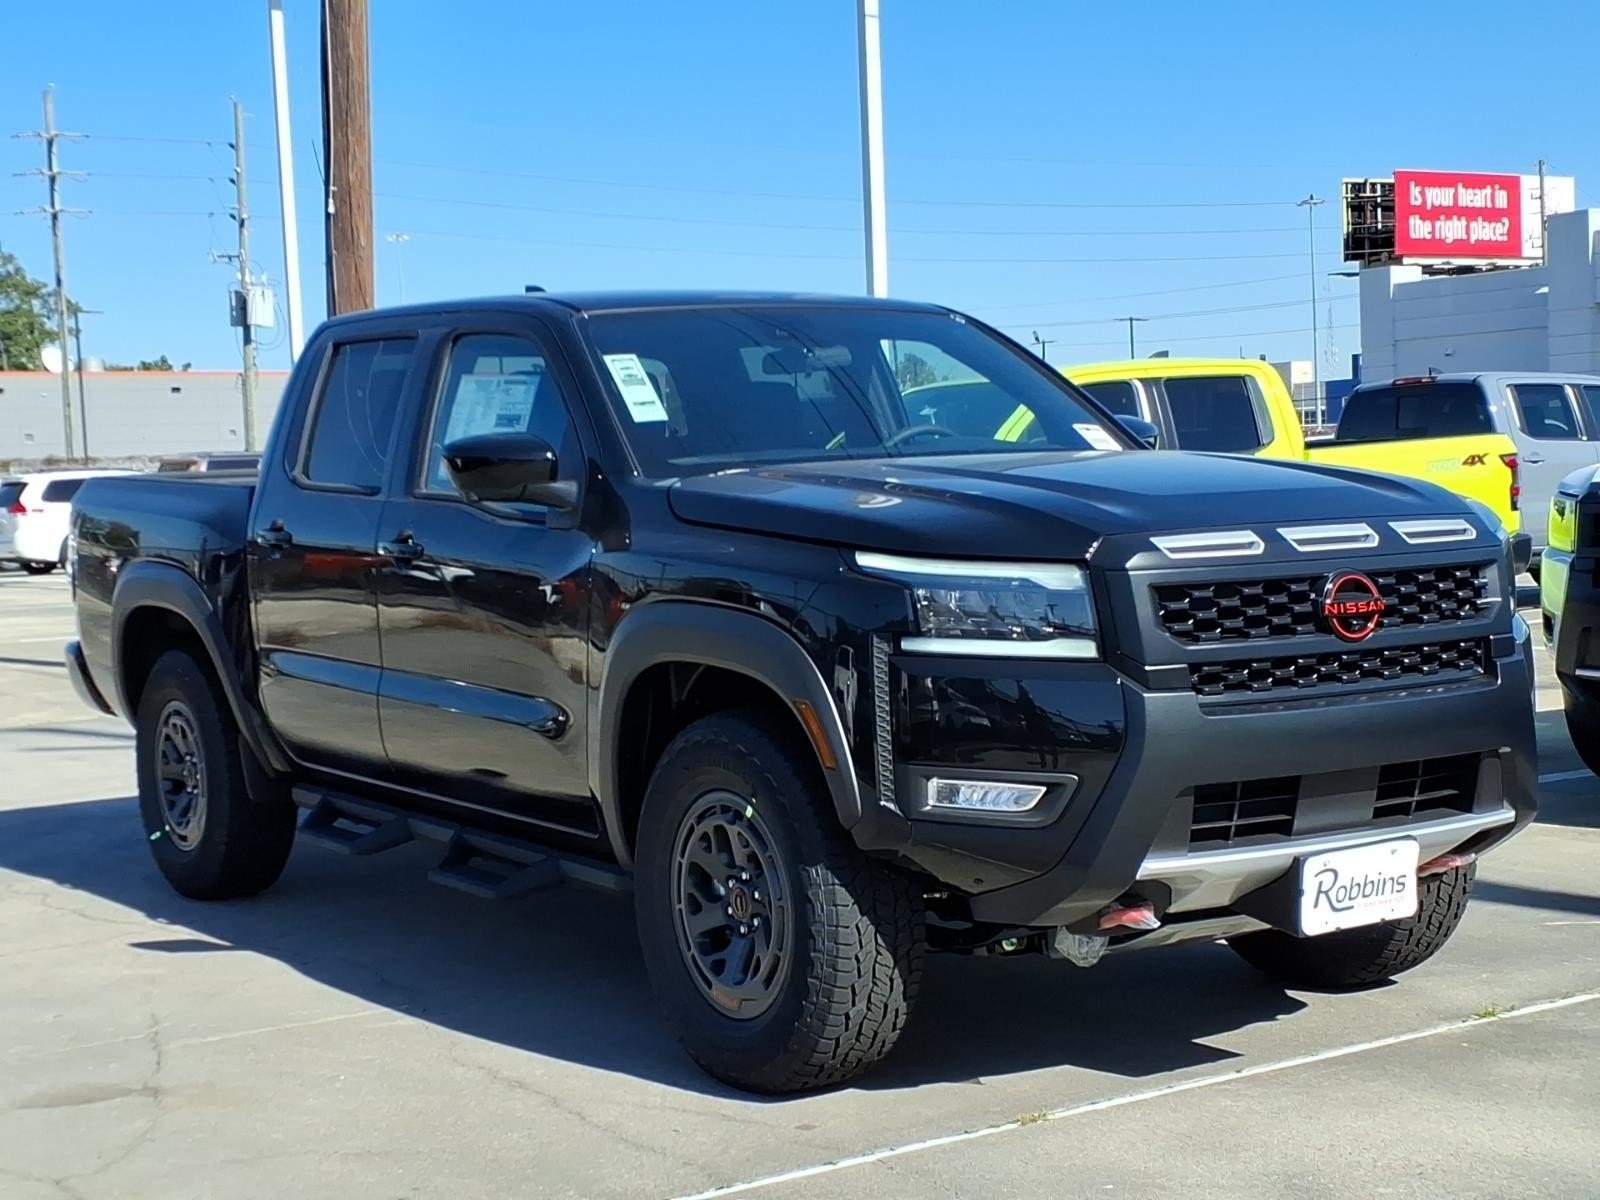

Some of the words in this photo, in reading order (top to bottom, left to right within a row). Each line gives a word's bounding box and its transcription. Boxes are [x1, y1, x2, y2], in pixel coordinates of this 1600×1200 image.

[1409, 181, 1422, 206] Is
[1424, 185, 1455, 210] your
[1457, 182, 1492, 208] heart
[1493, 186, 1508, 209] in
[1409, 216, 1432, 240] the
[1434, 216, 1467, 244] right
[1470, 216, 1509, 244] place?
[1324, 600, 1385, 615] NISSAN
[1313, 867, 1407, 912] Robbins
